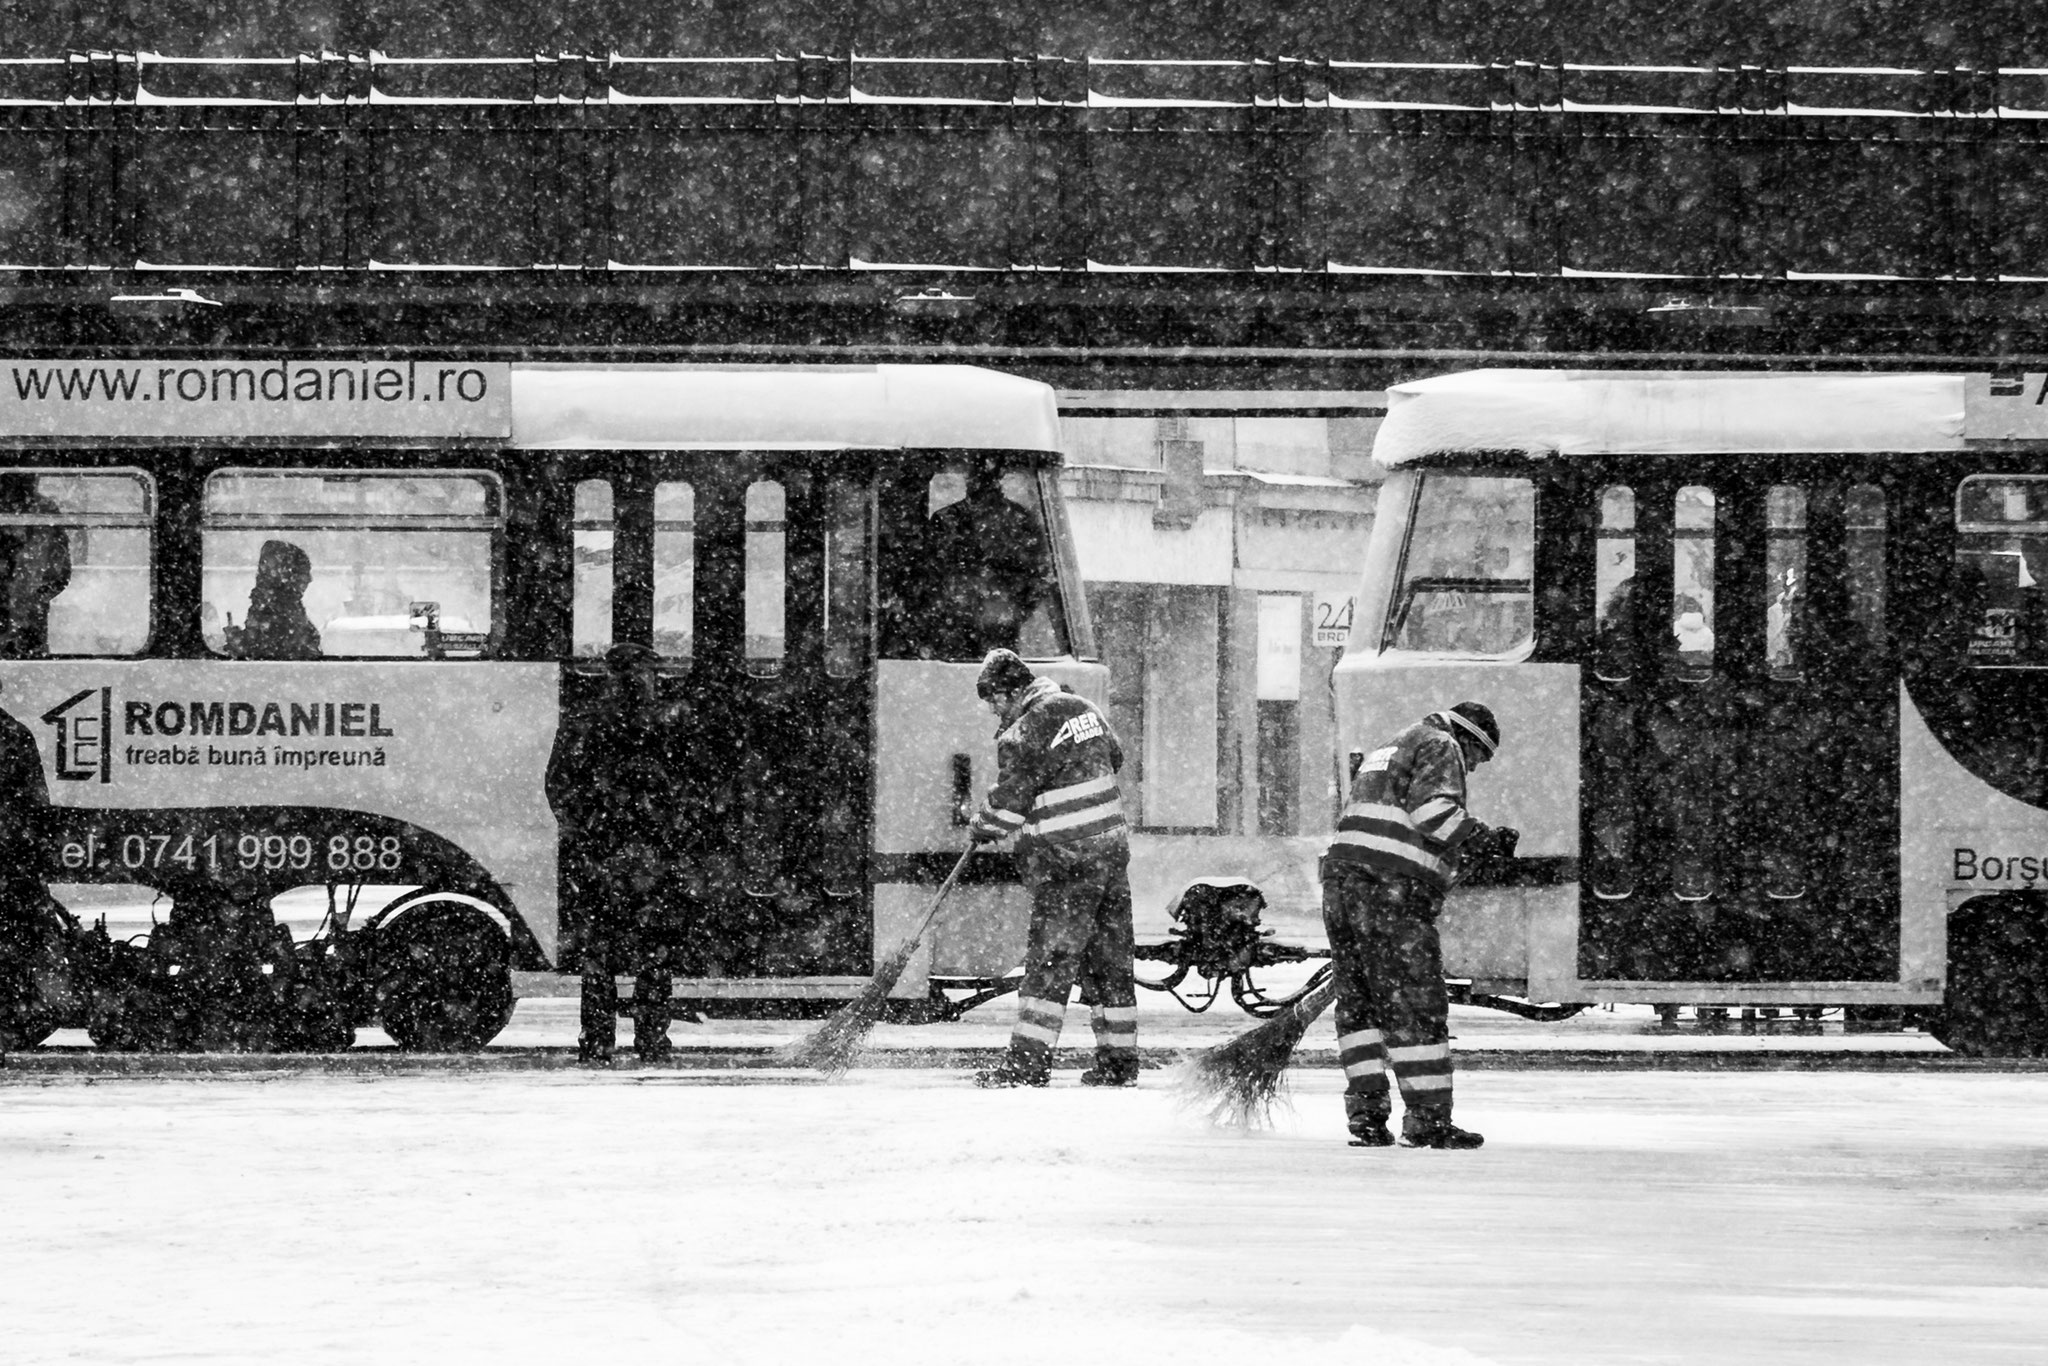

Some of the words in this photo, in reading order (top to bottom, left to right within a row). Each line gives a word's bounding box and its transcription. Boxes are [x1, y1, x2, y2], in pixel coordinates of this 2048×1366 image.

[11, 360, 488, 401] www.romdaniel.ro
[1317, 596, 1354, 636] 24
[125, 701, 394, 737] ROMDANIEL
[125, 744, 200, 765] treabă
[208, 744, 266, 766] bună
[273, 745, 386, 771] împreună
[60, 833, 111, 869] el:
[122, 834, 220, 869] 0741
[237, 835, 313, 869] 999
[327, 836, 401, 870] 888
[1954, 847, 2048, 889] Borş
